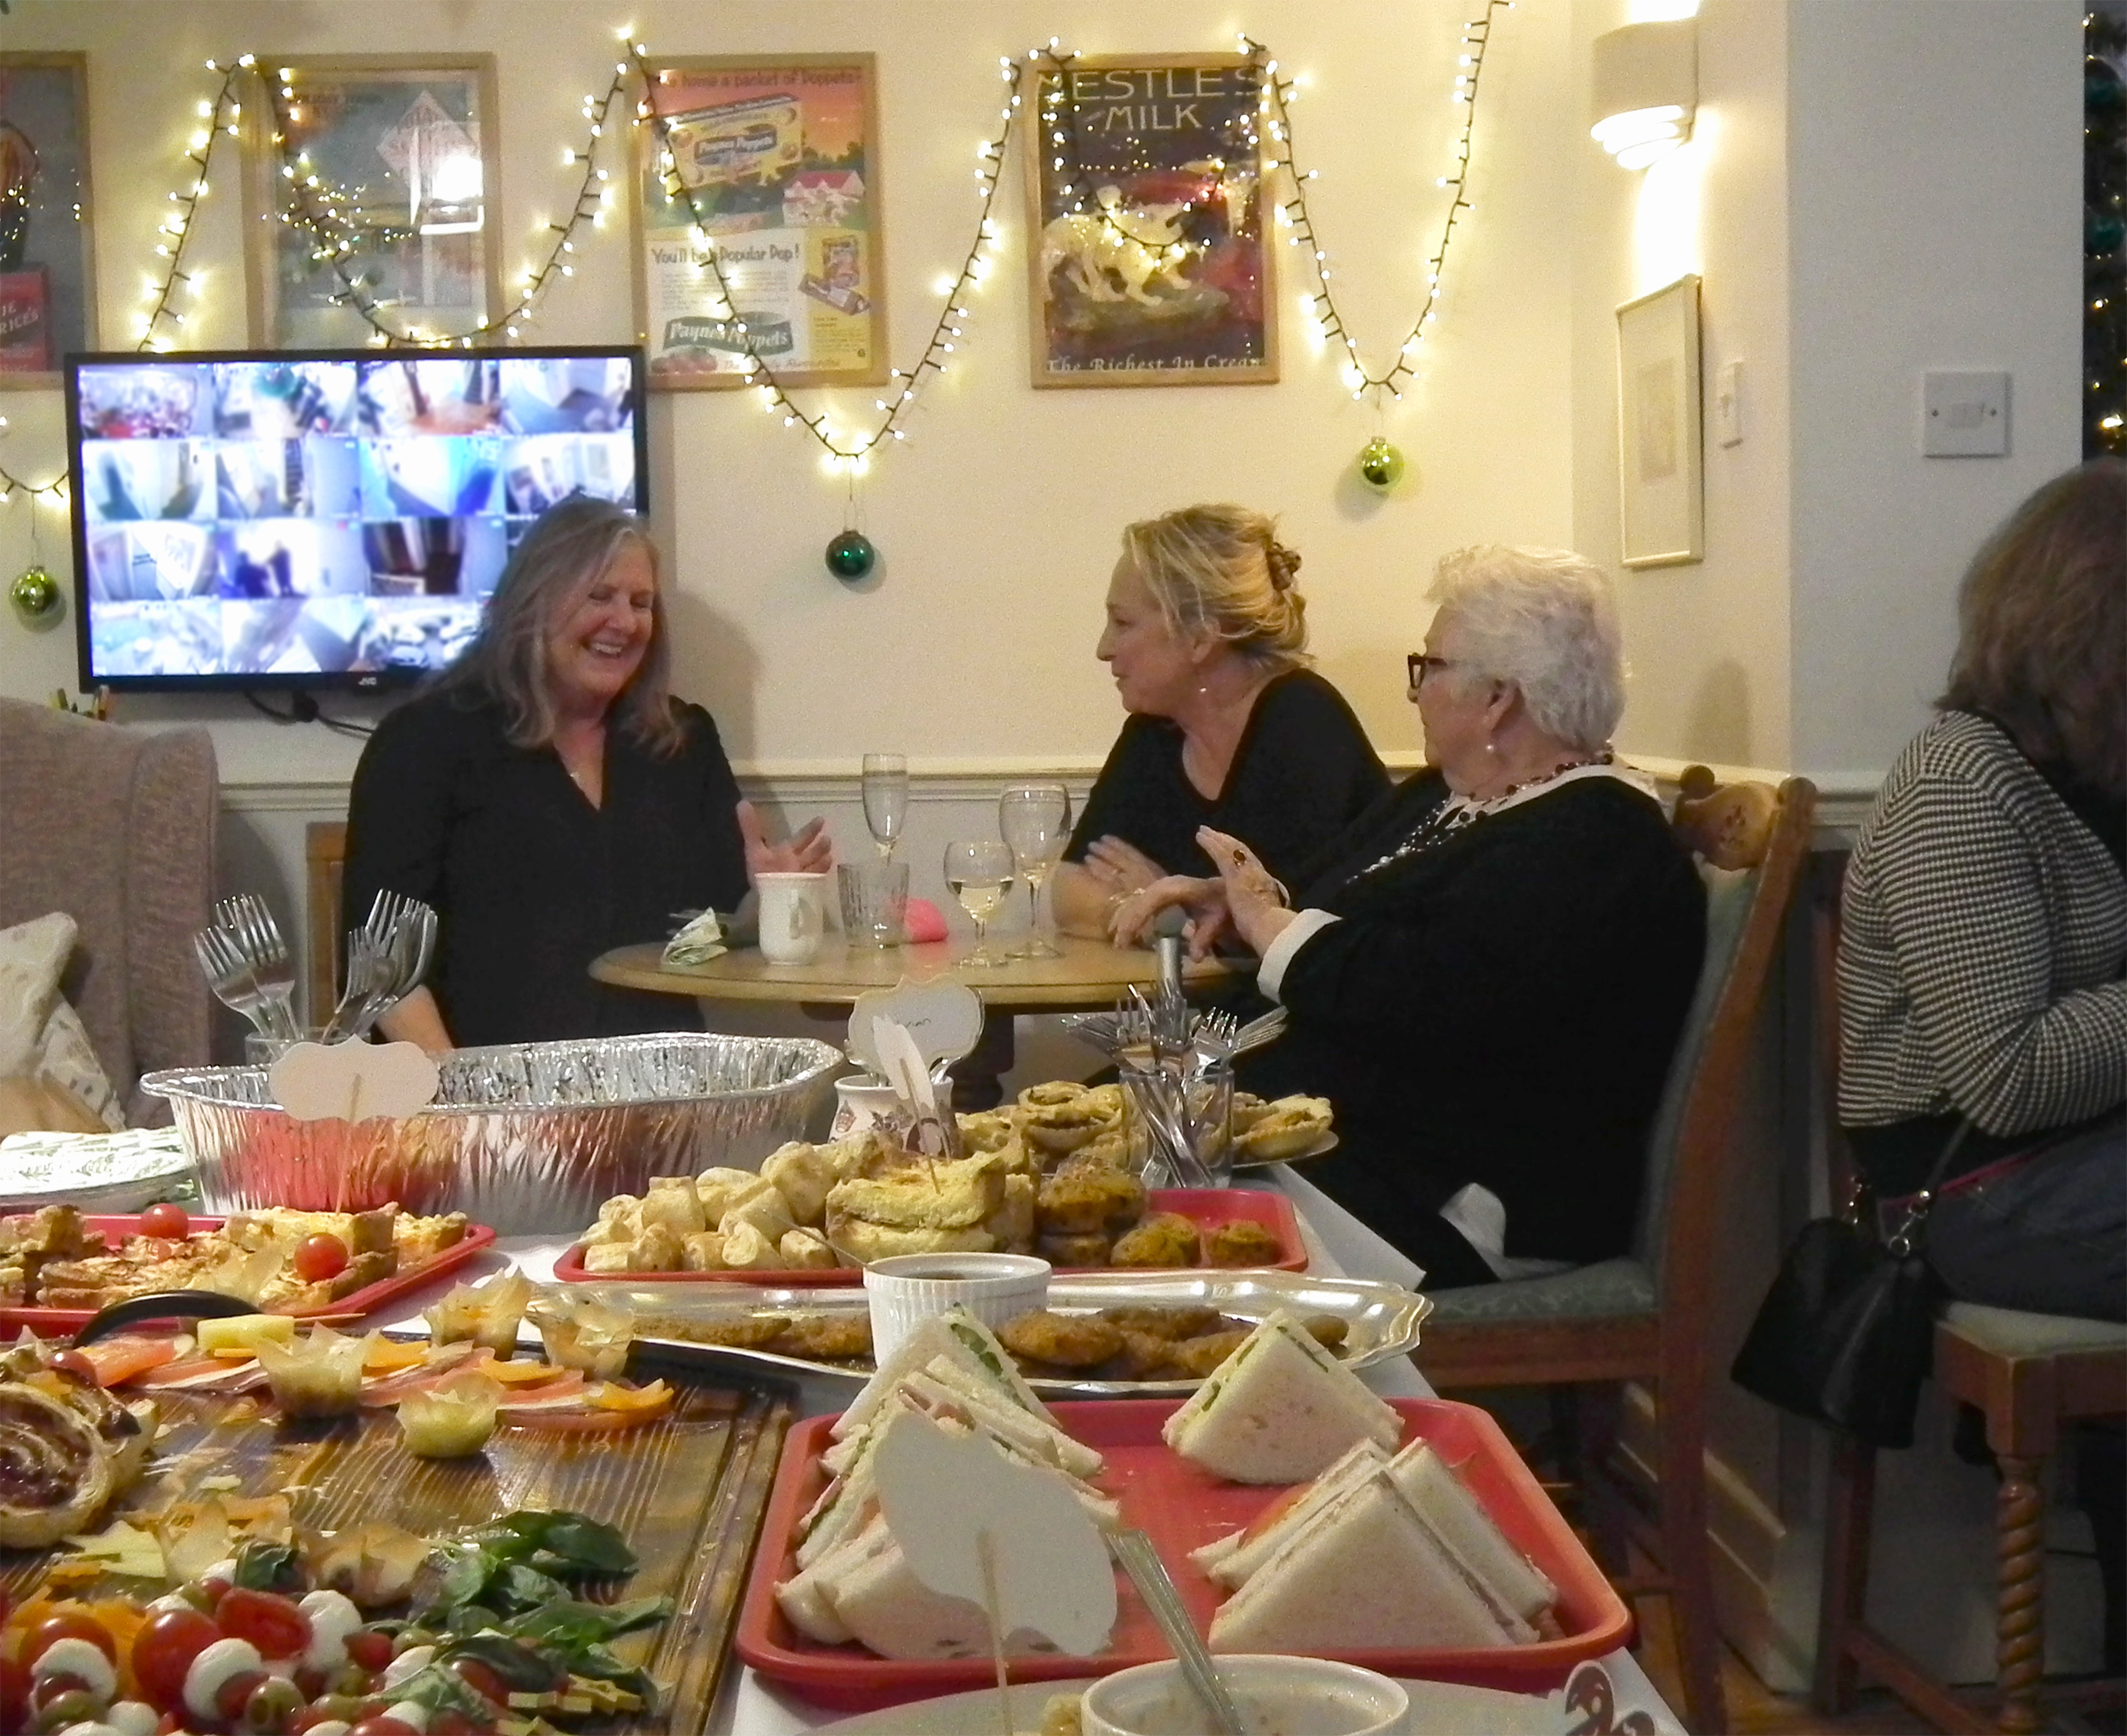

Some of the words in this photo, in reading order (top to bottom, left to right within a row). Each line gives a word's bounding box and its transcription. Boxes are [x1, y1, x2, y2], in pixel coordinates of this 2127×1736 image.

[1104, 104, 1203, 130] MILK
[718, 245, 767, 263] Popular
[1048, 355, 1081, 372] The
[1090, 354, 1164, 371] Richest
[1172, 355, 1195, 370] In
